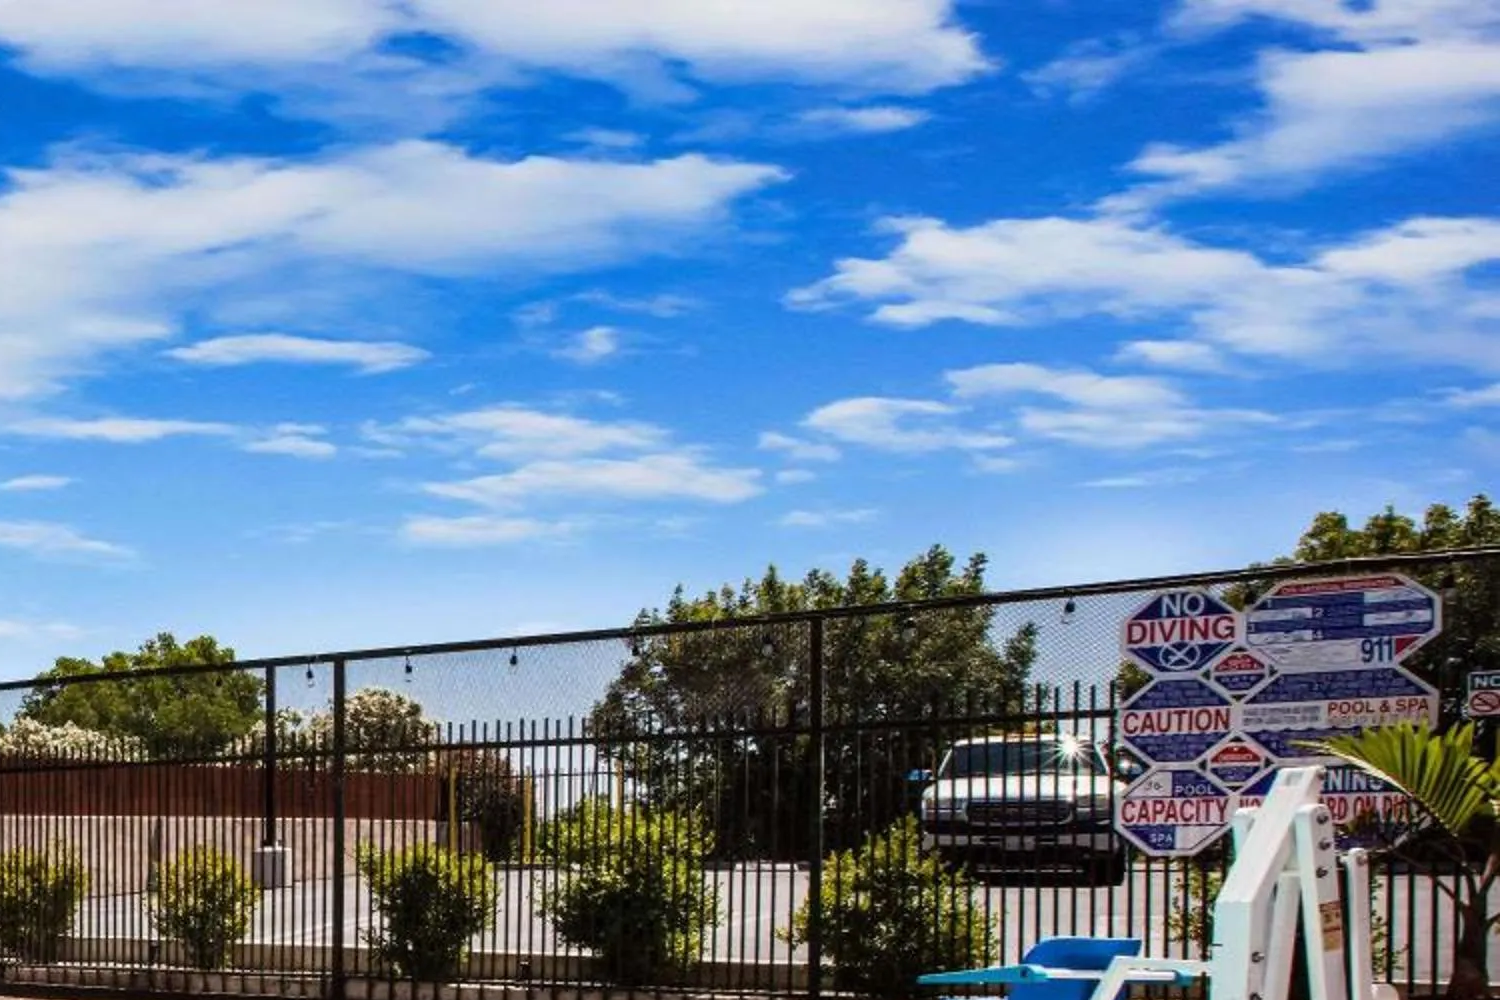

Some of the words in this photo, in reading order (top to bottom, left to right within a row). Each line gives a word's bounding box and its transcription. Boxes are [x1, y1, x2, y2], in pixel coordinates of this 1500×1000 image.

[1162, 594, 1205, 617] NO
[1127, 616, 1236, 645] DIVING
[1361, 636, 1393, 664] 911
[1327, 701, 1376, 716] POOL
[1380, 700, 1391, 714] &
[1396, 697, 1430, 712] SPA
[1123, 708, 1231, 734] CAUTION
[1174, 783, 1216, 796] POOL
[1121, 798, 1229, 823] CAPACITY
[1149, 832, 1173, 844] SPA
